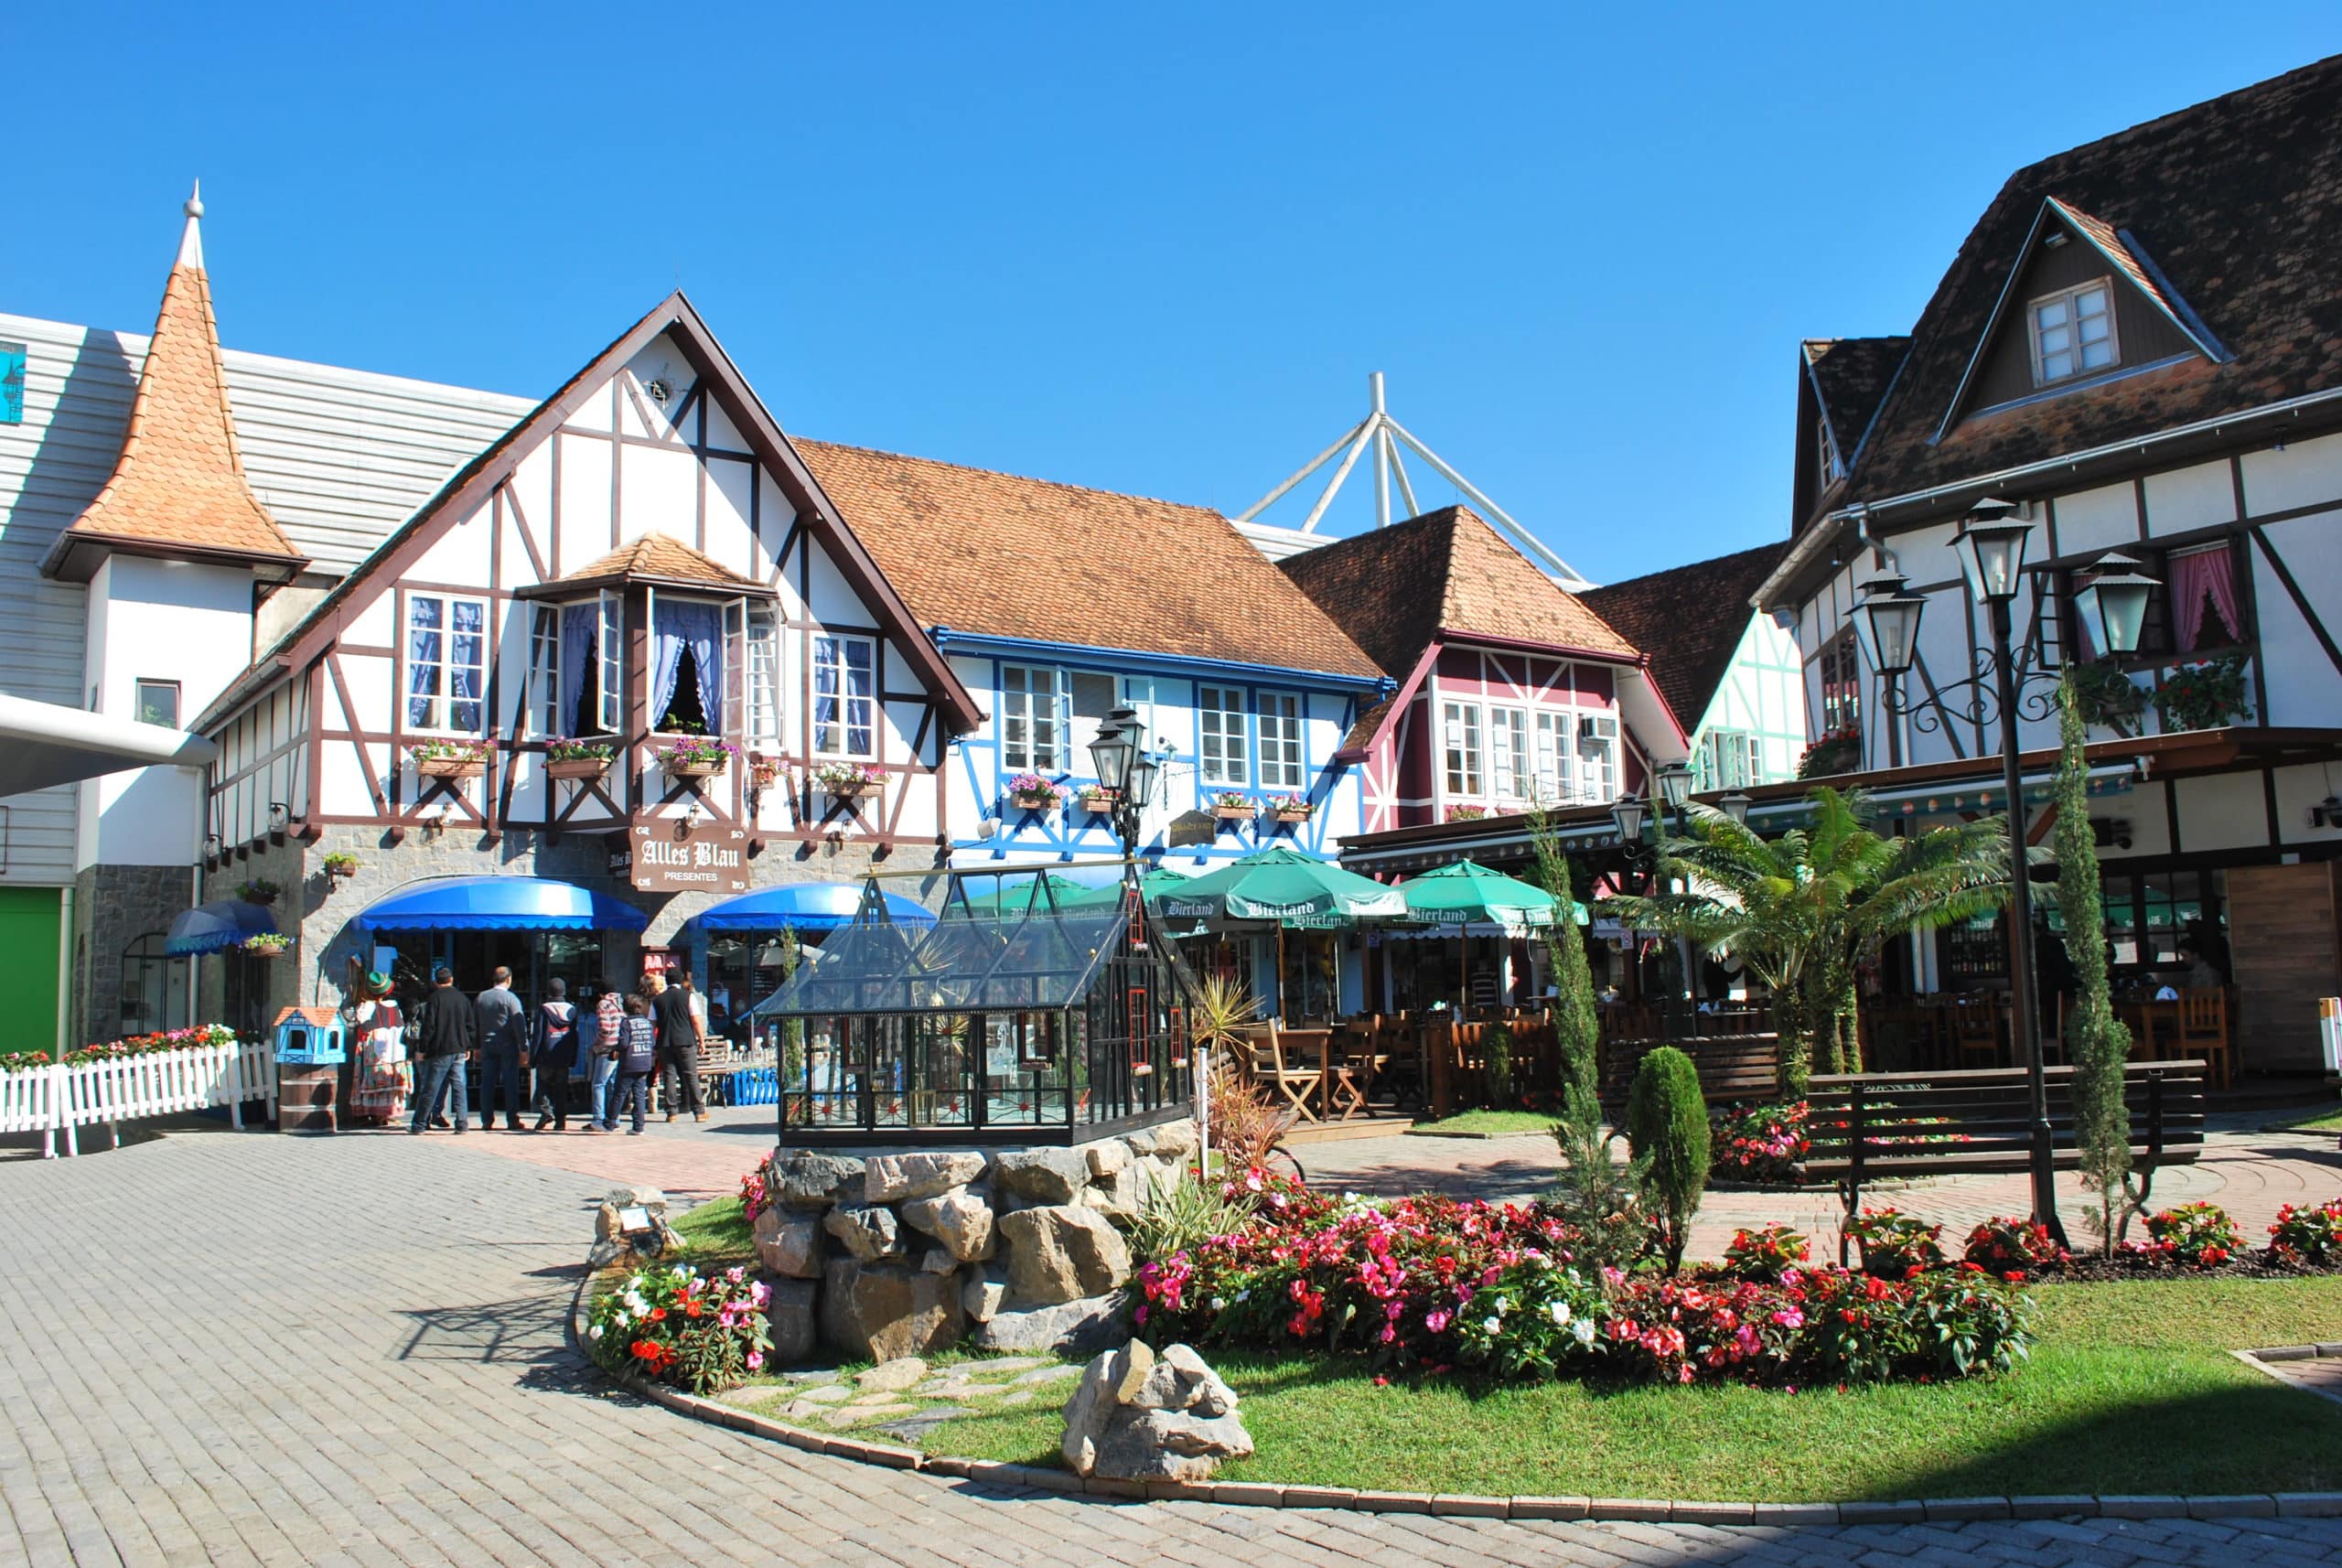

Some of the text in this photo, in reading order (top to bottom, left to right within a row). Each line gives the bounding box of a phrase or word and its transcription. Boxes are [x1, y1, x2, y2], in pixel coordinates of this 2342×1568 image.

[641, 840, 689, 865] Alles
[693, 841, 739, 869] Blau
[664, 871, 718, 882] PRESENTES
[1167, 901, 1215, 916] Bierland
[1247, 901, 1316, 916] Bierland
[1407, 907, 1467, 922] Bierland
[1292, 915, 1348, 927] Bierlan
